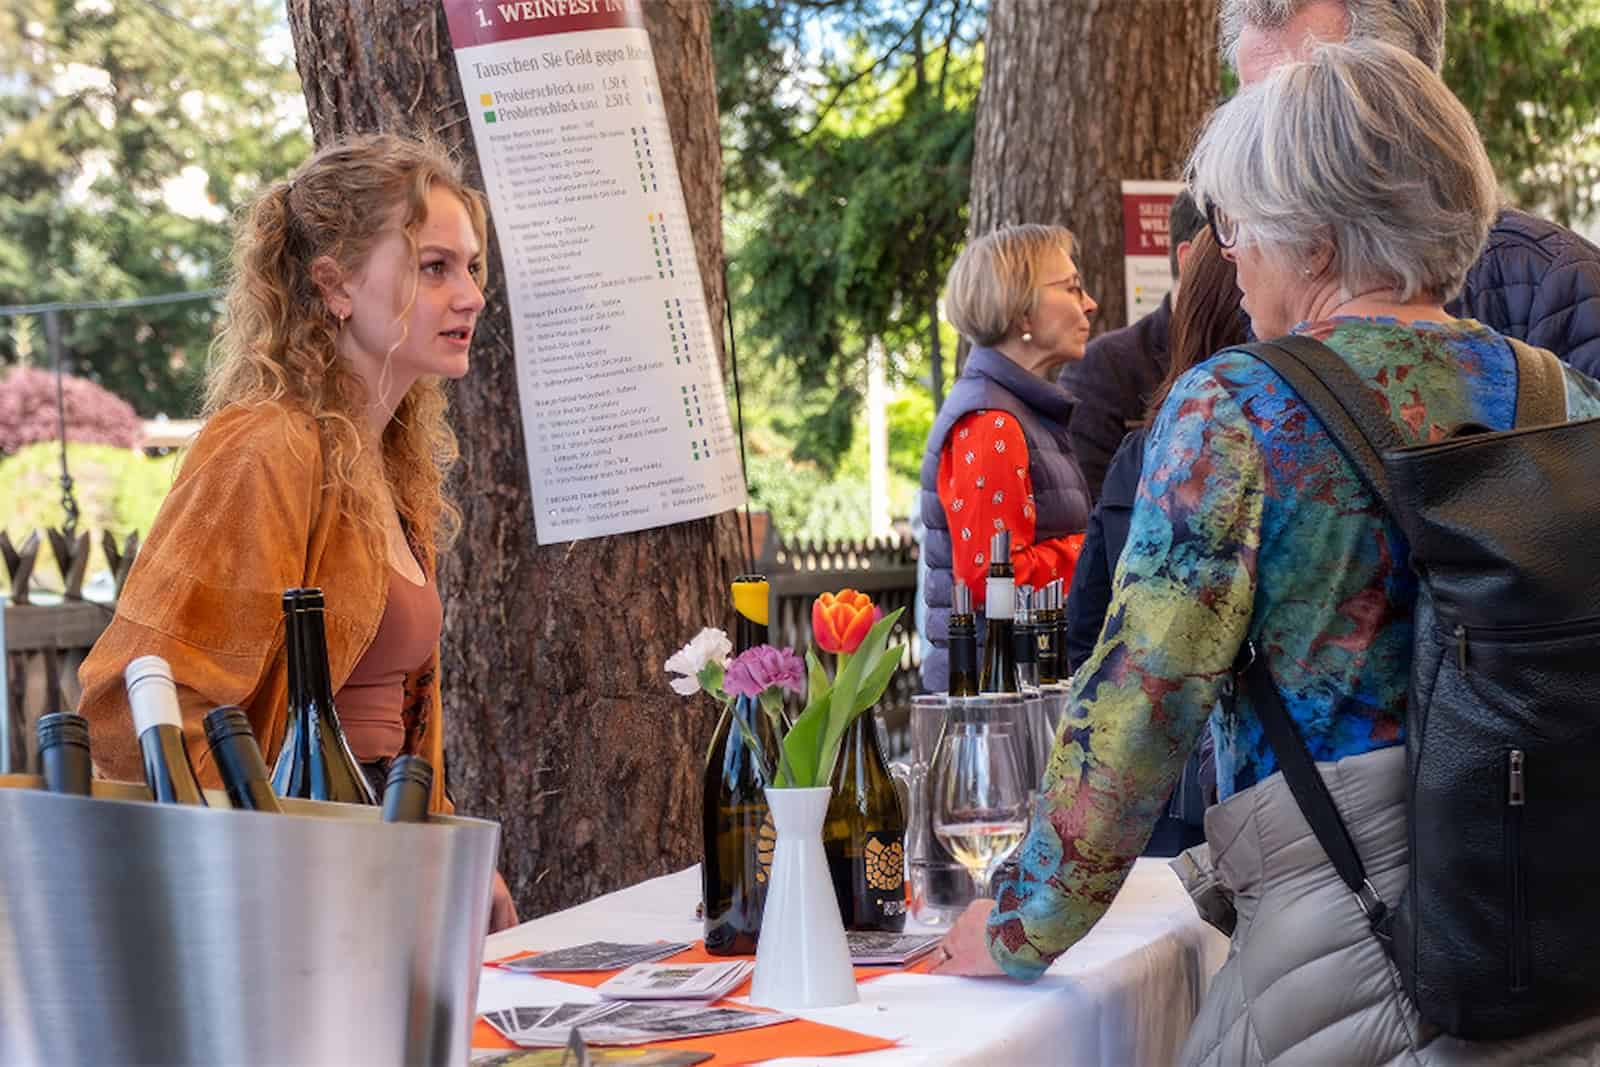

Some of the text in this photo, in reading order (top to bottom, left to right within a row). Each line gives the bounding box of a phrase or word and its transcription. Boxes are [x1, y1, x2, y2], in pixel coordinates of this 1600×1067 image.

[475, 8, 492, 27] 1.
[497, 0, 598, 23] WEINFEST
[472, 57, 540, 79] Tauschen
[542, 51, 562, 69] Sie
[565, 47, 592, 65] Geld
